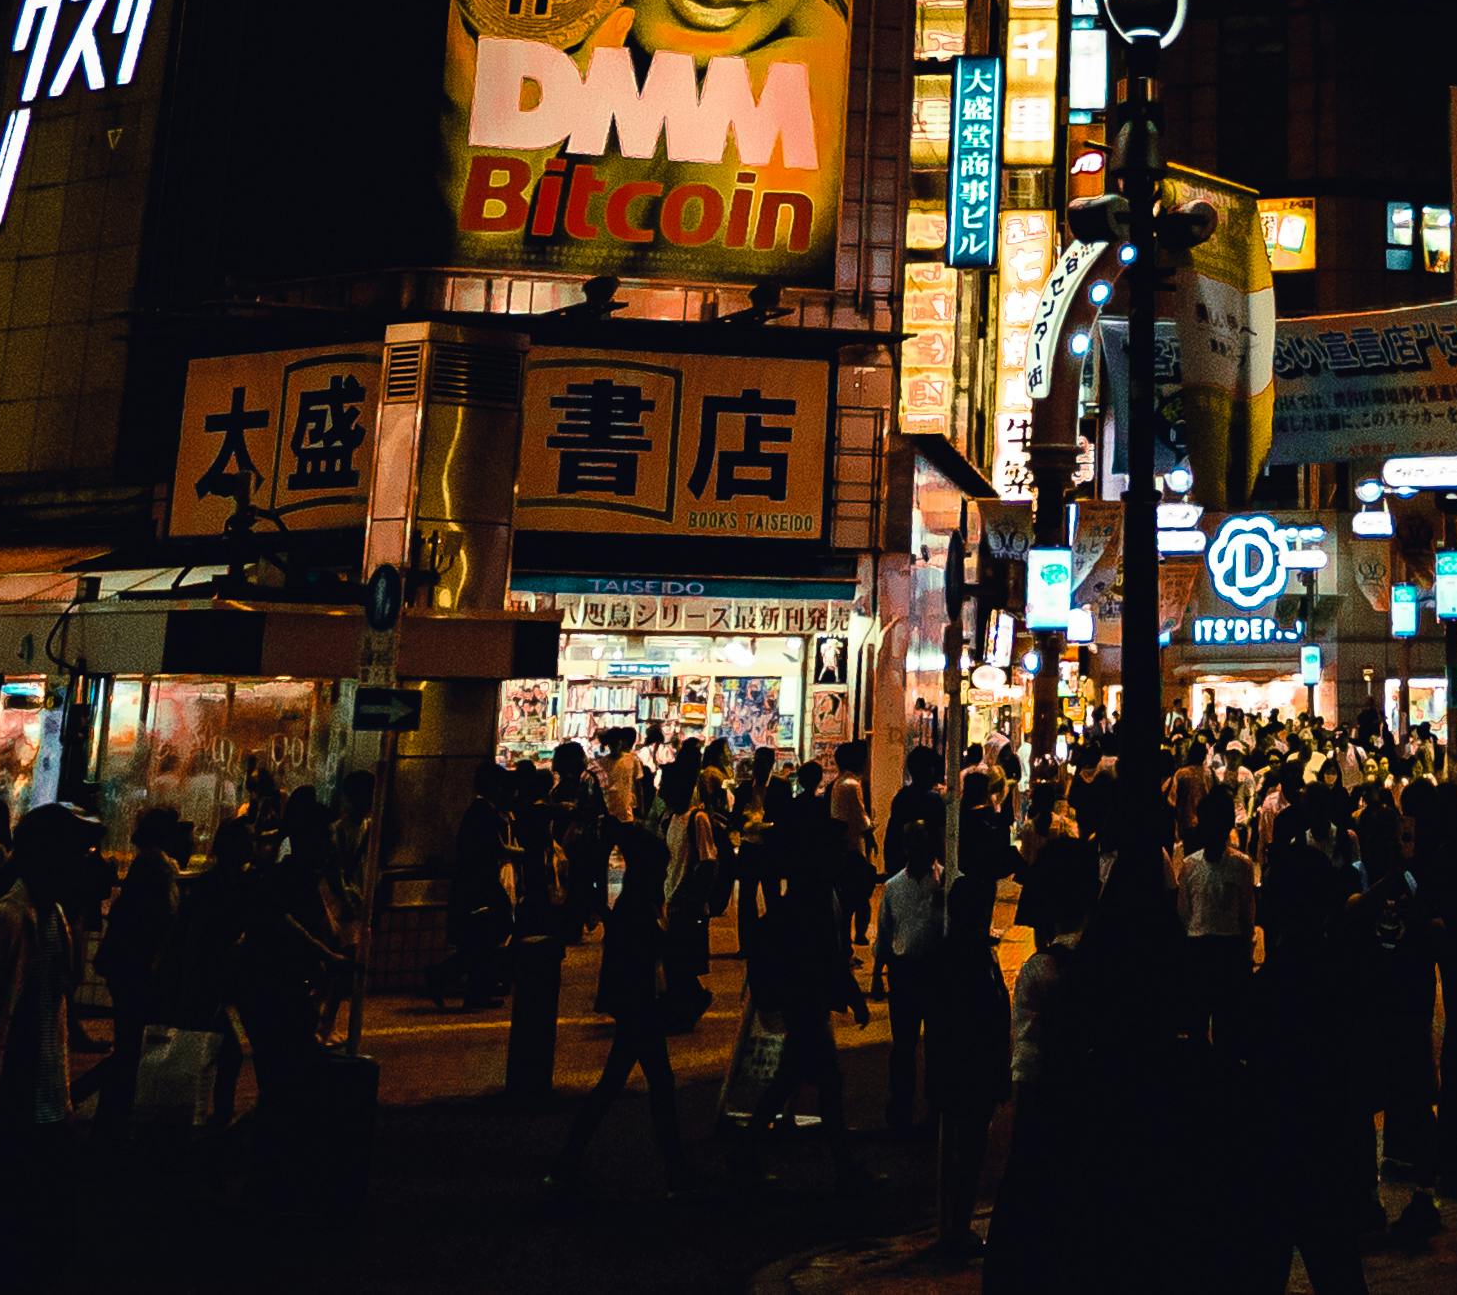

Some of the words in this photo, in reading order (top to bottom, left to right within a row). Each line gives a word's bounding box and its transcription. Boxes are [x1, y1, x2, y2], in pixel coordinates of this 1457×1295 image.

[468, 34, 819, 170] DMM
[458, 155, 814, 254] Bitcoin
[957, 68, 993, 256] 大盛堂商事ビル
[688, 512, 740, 532] BOOKS
[744, 513, 814, 533] TAISEIDO
[588, 578, 706, 597] TAISEIDO
